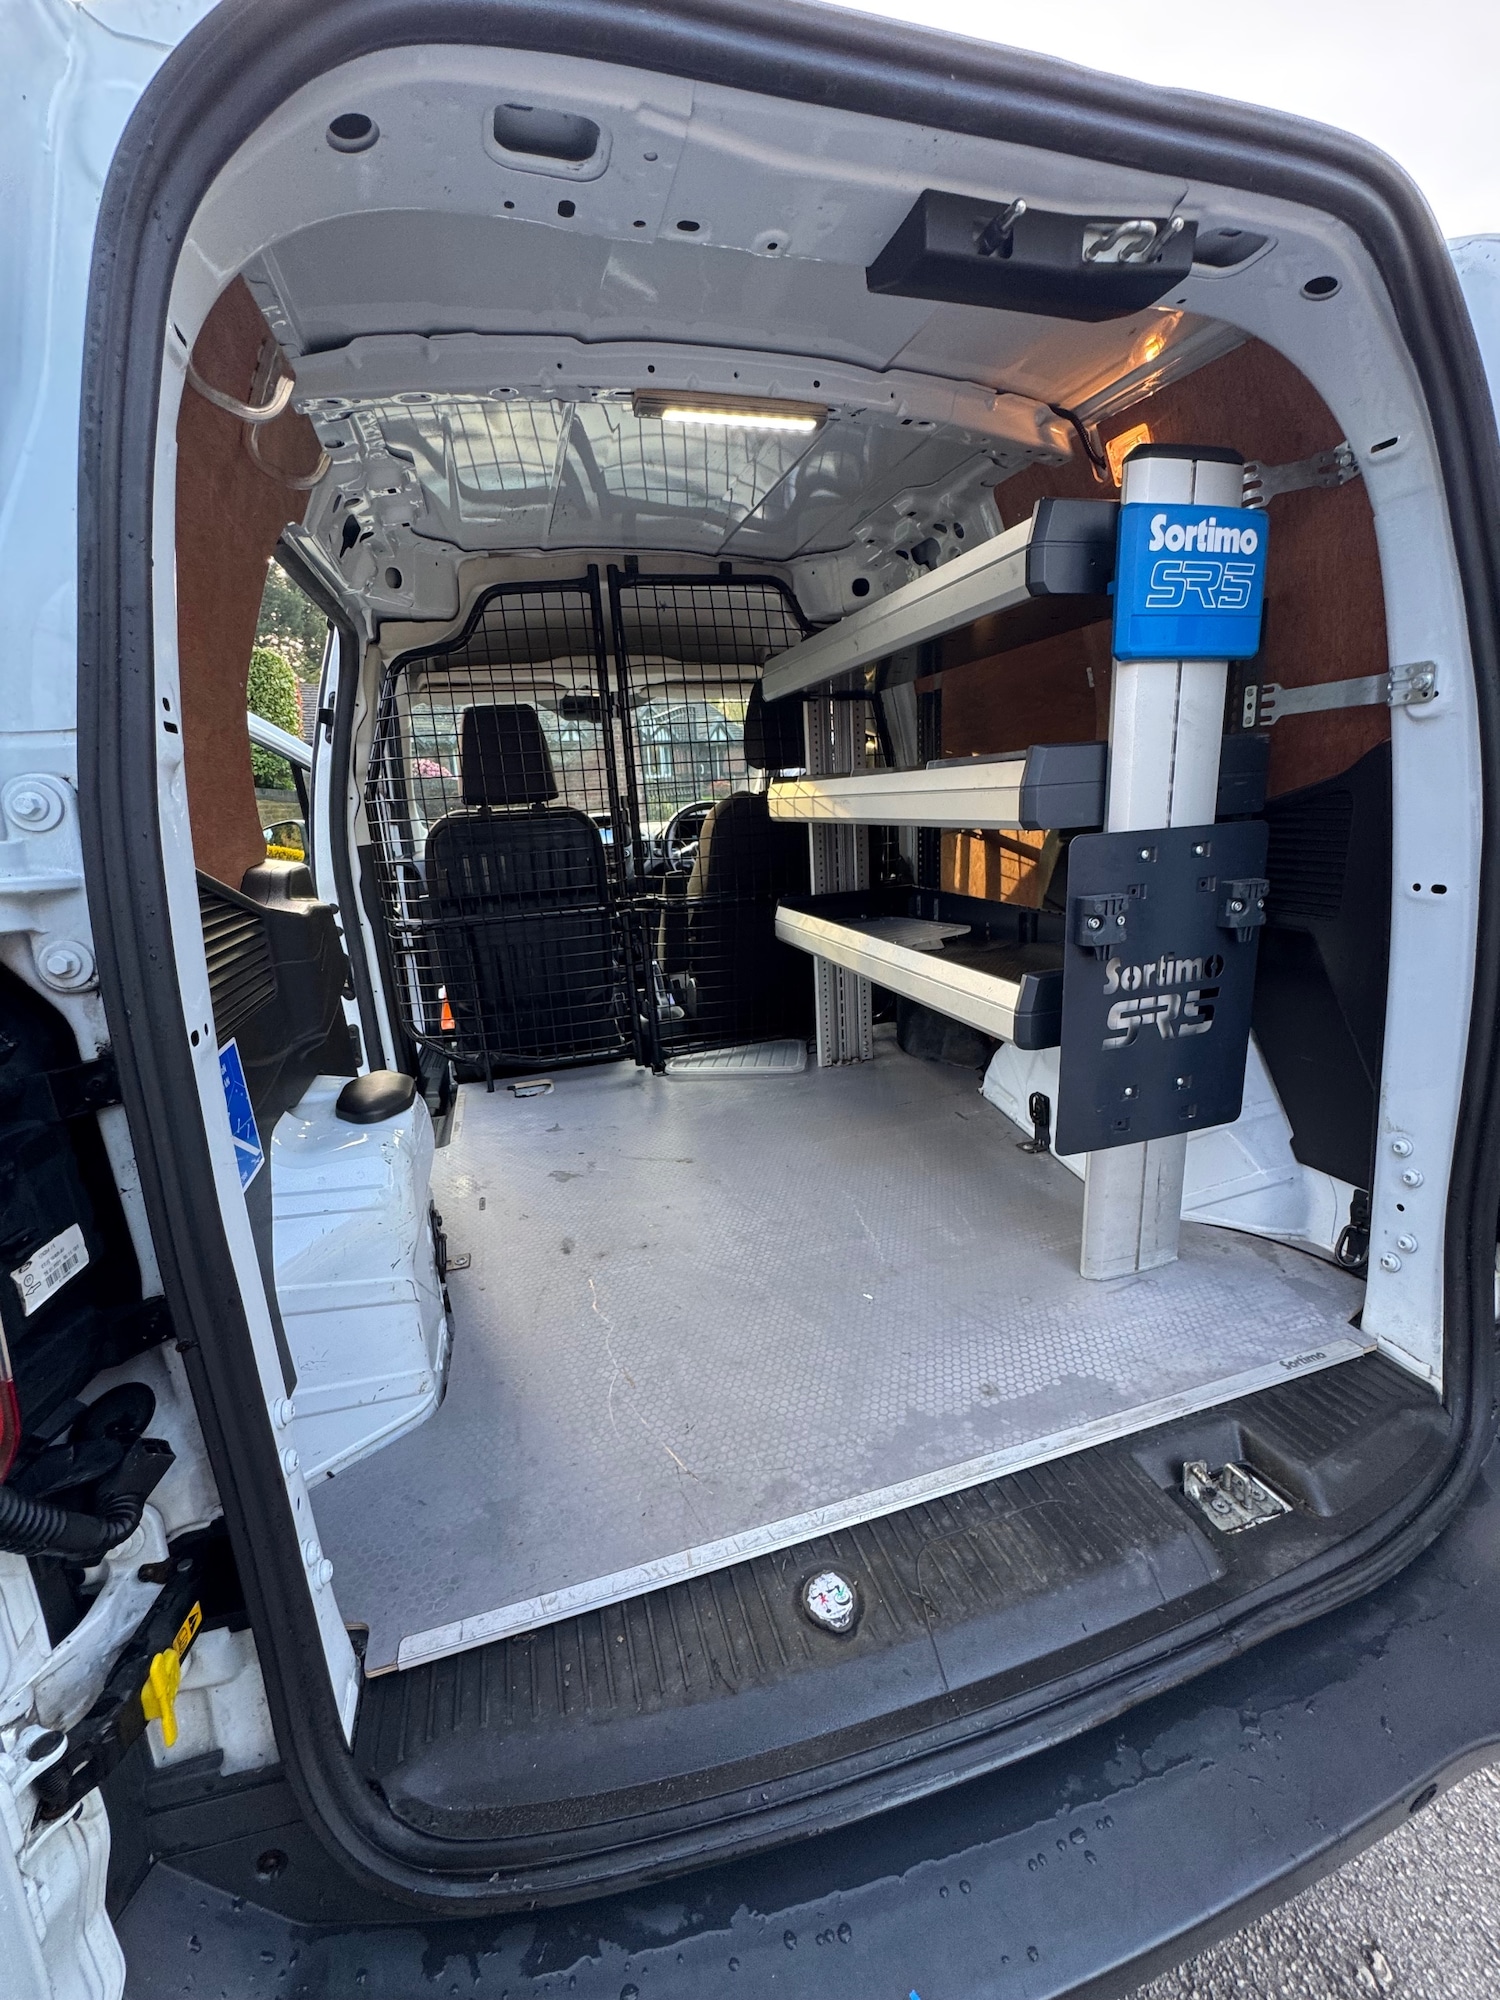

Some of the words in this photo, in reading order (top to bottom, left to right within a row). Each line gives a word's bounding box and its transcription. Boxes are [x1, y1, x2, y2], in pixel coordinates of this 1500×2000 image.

[1149, 513, 1258, 555] Sortimo
[1145, 560, 1256, 609] SR5
[1103, 951, 1225, 995] Sortimo
[1279, 1351, 1327, 1370] Sortimo
